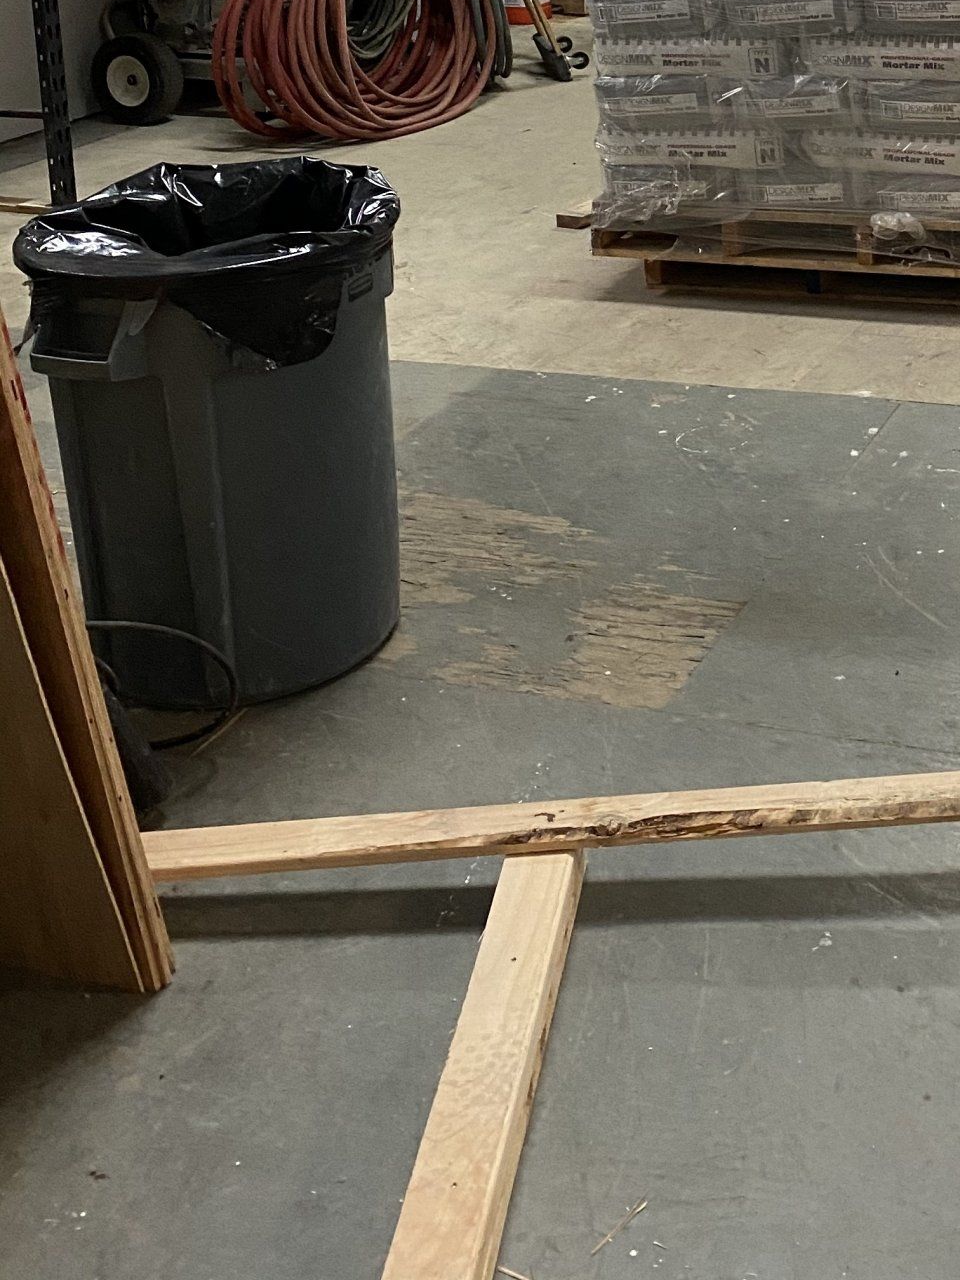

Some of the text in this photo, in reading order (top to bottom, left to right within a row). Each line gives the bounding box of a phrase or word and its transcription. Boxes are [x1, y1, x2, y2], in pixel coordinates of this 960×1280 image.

[663, 59, 699, 67] Mortar
[754, 57, 770, 73] N
[882, 62, 945, 70] Mortar Mix
[668, 149, 727, 158] Mortar Mix
[761, 148, 775, 164] N
[883, 154, 945, 166] Mortar Mix
